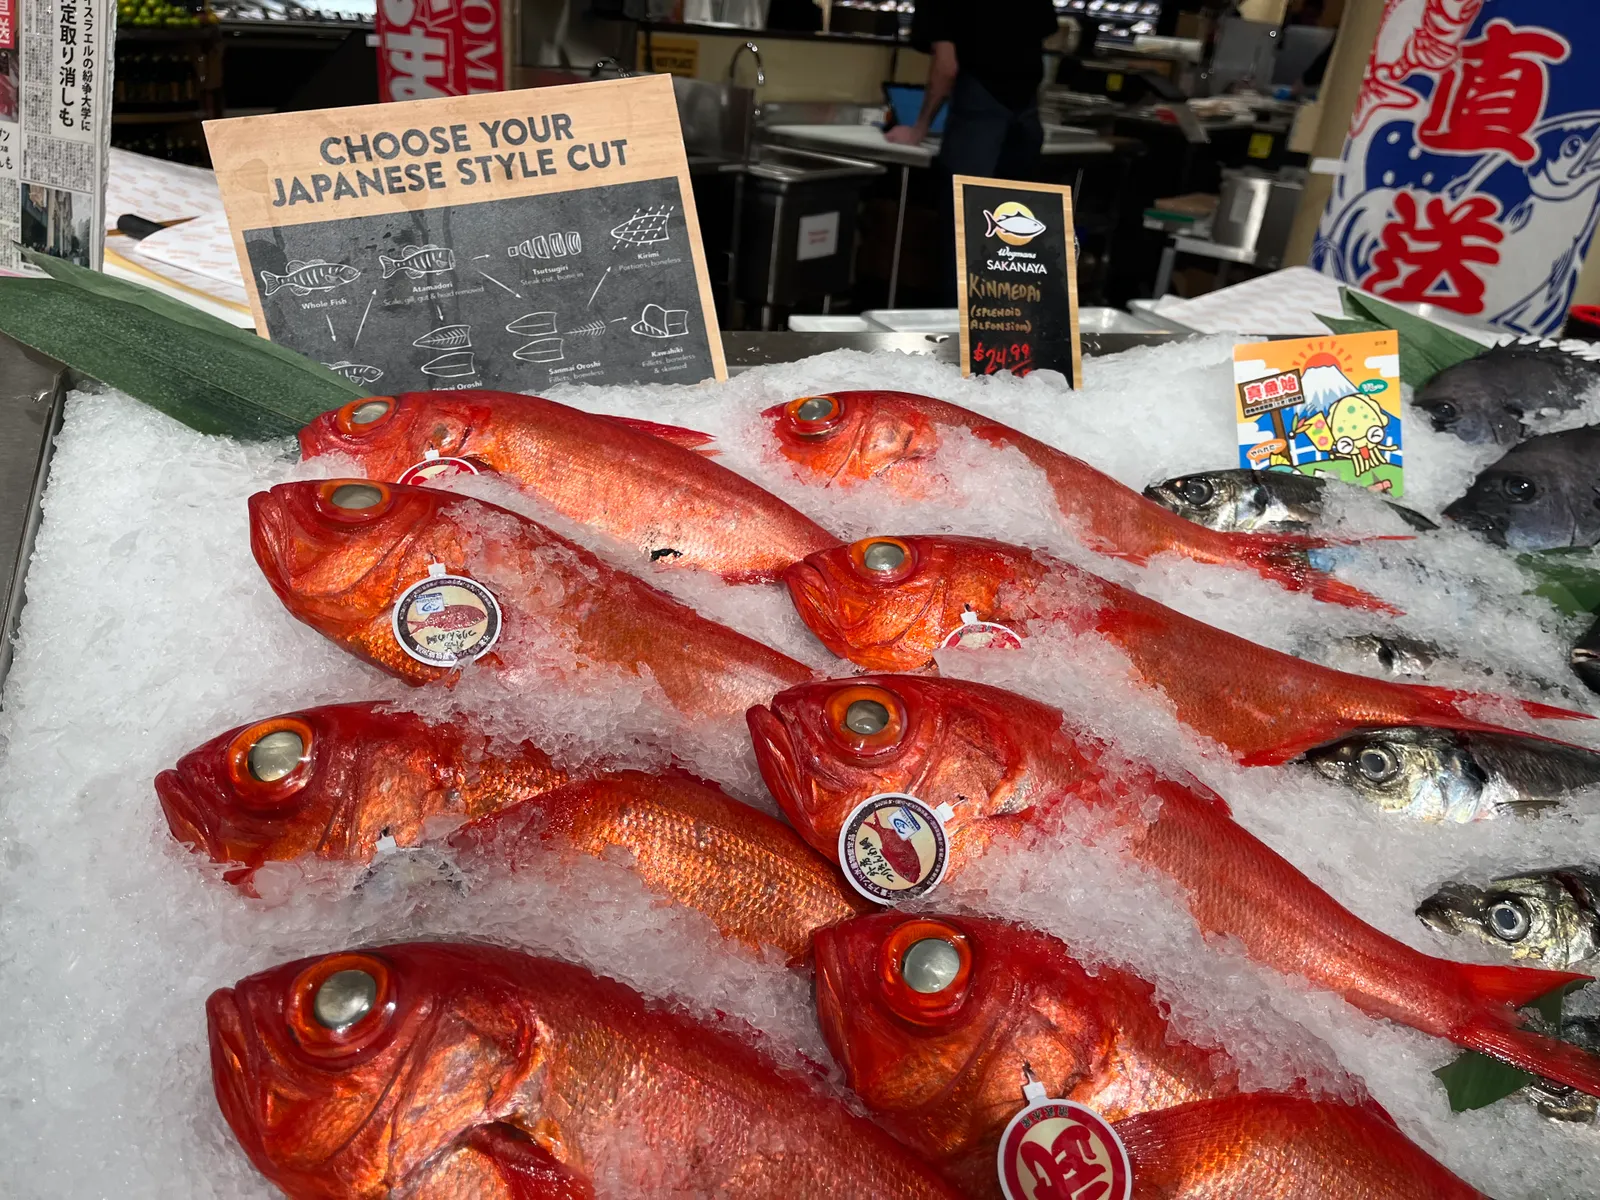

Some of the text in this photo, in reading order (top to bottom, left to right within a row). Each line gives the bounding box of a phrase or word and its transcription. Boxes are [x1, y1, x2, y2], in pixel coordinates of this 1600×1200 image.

[319, 112, 574, 166] CHOOSE YOUR
[272, 138, 629, 207] JAPANESE STYLE CUT
[1362, 24, 1570, 314] 直送
[637, 250, 660, 260] Kirimi
[532, 264, 569, 275] Tsutsugiri
[986, 259, 1048, 275] SAKANAYA
[412, 283, 453, 293] Atamadori
[301, 297, 348, 309] Whole Fish
[650, 347, 684, 357] Kawahiki
[548, 360, 601, 375] Sanmai Oroshi
[456, 380, 483, 390] Oroshi
